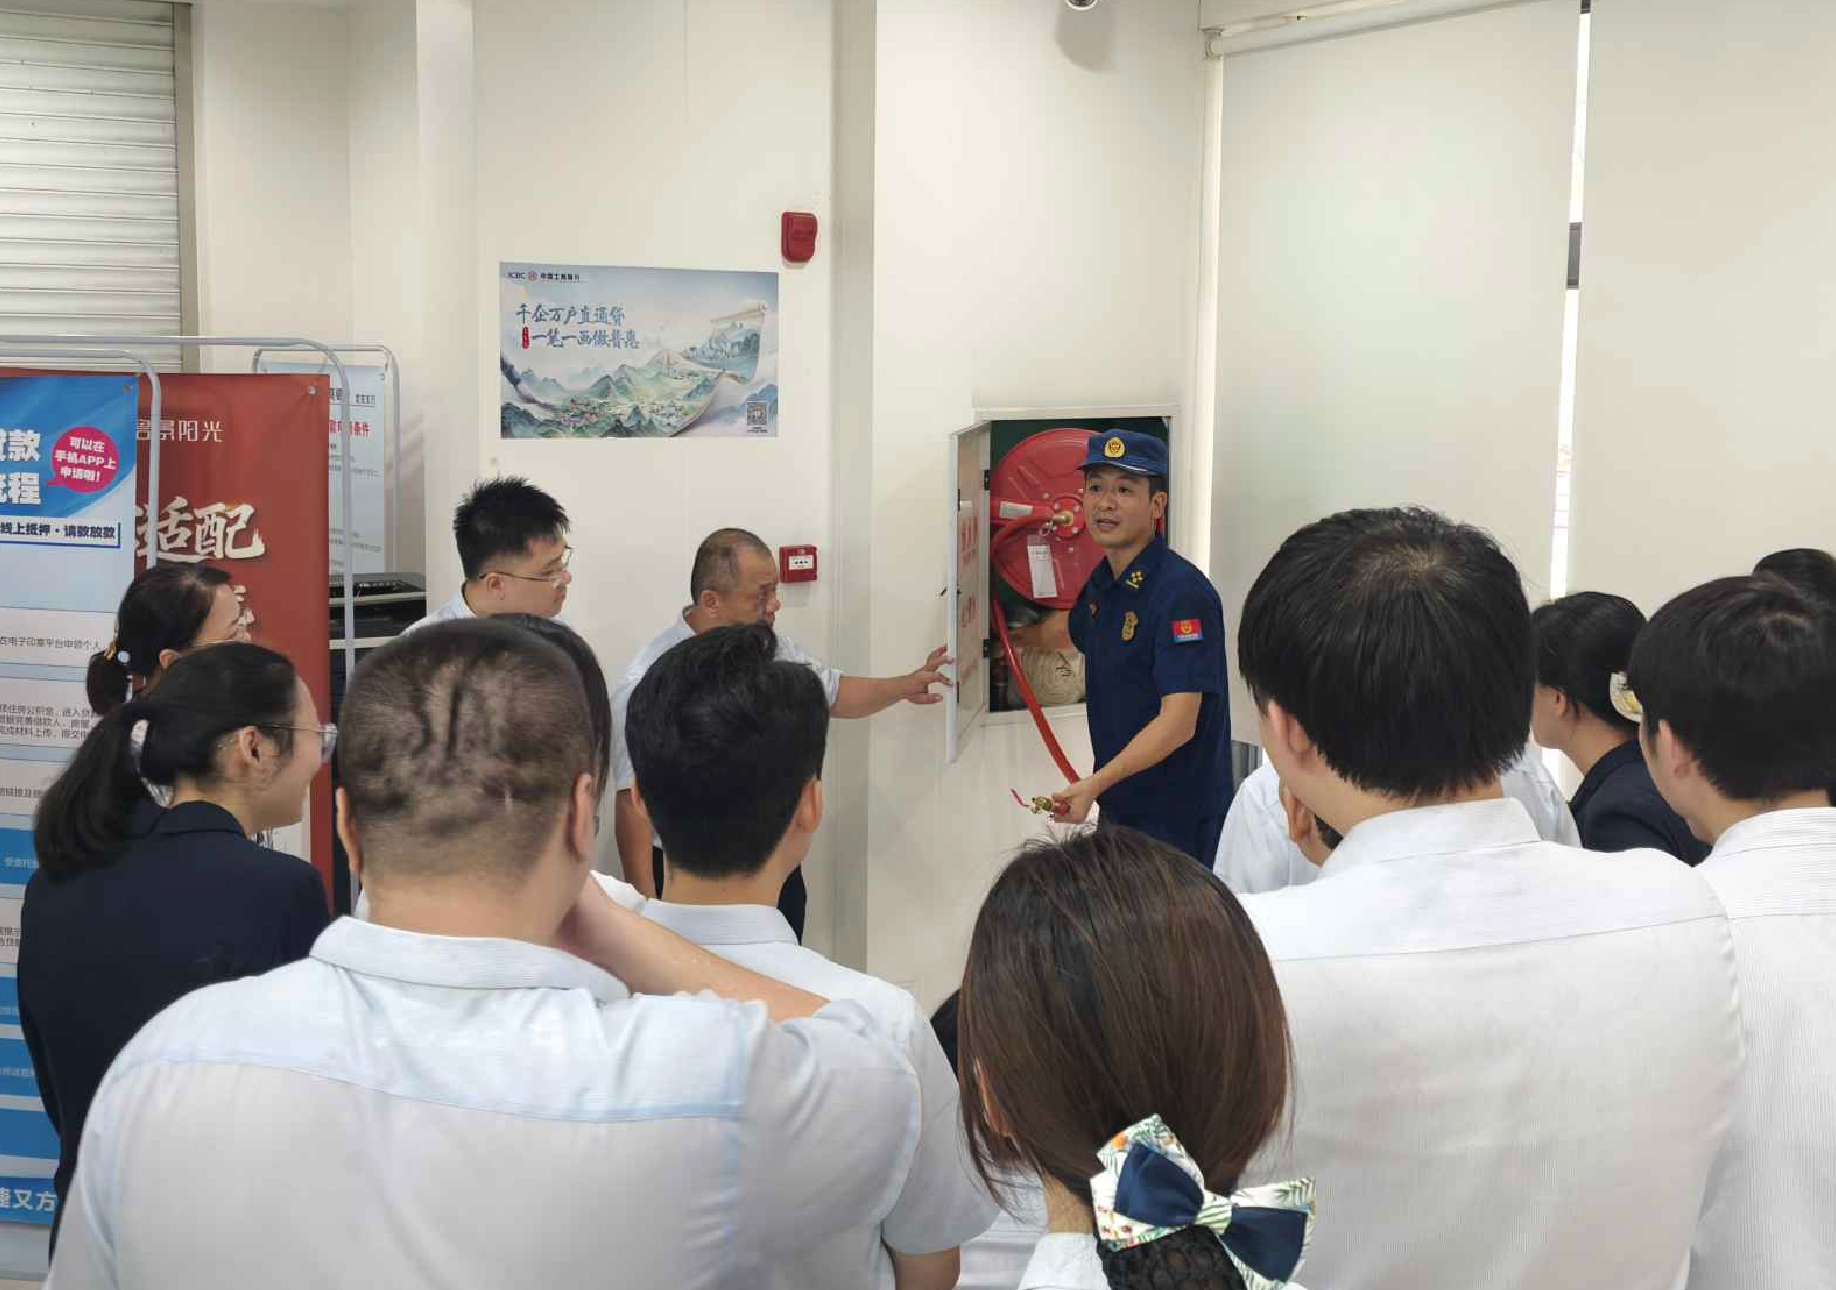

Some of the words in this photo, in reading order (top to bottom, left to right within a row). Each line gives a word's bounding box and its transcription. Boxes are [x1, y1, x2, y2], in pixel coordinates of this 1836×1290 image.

[0, 428, 41, 461] 款
[55, 449, 117, 470] 手机APP上
[69, 436, 105, 453] 可以在
[0, 472, 41, 504] 程
[135, 496, 265, 564] 适配
